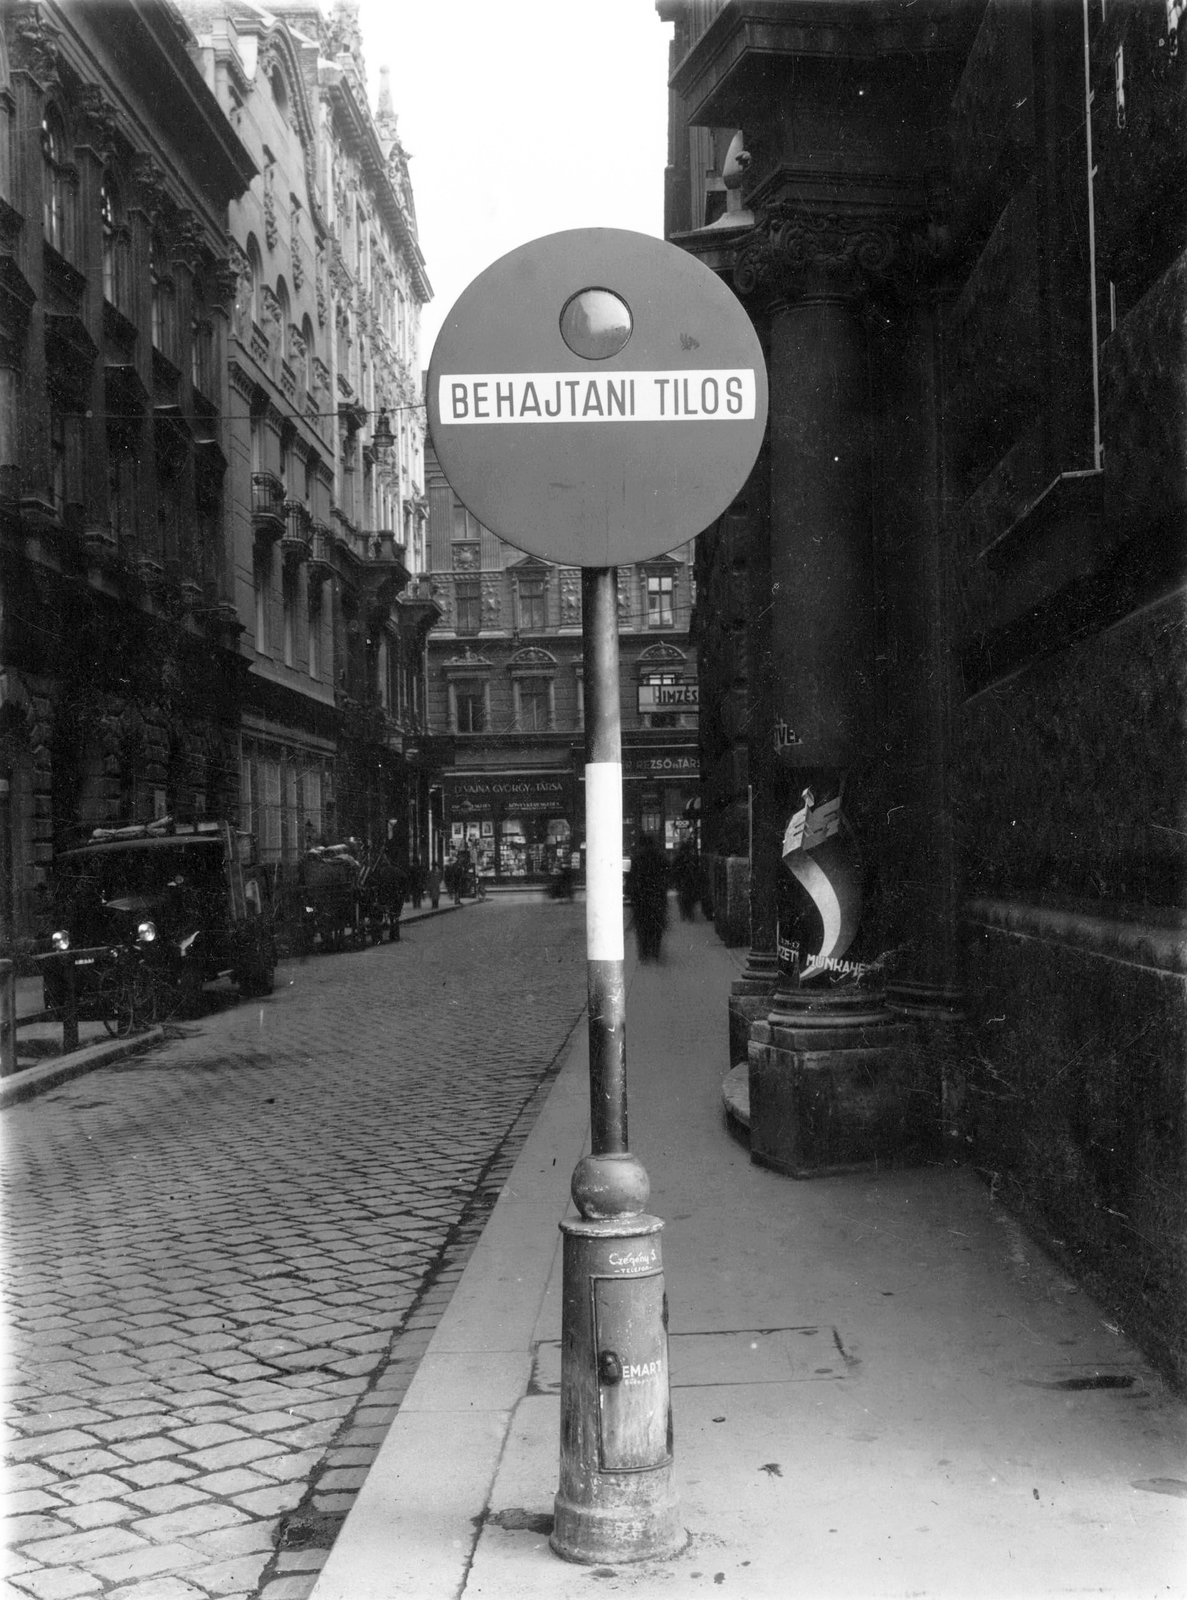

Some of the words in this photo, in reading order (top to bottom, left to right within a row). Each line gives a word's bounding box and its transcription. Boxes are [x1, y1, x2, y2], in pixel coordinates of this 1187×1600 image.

[451, 378, 635, 419] BEHAJTANI
[654, 376, 743, 416] TILOS
[622, 1360, 662, 1378] EMART
